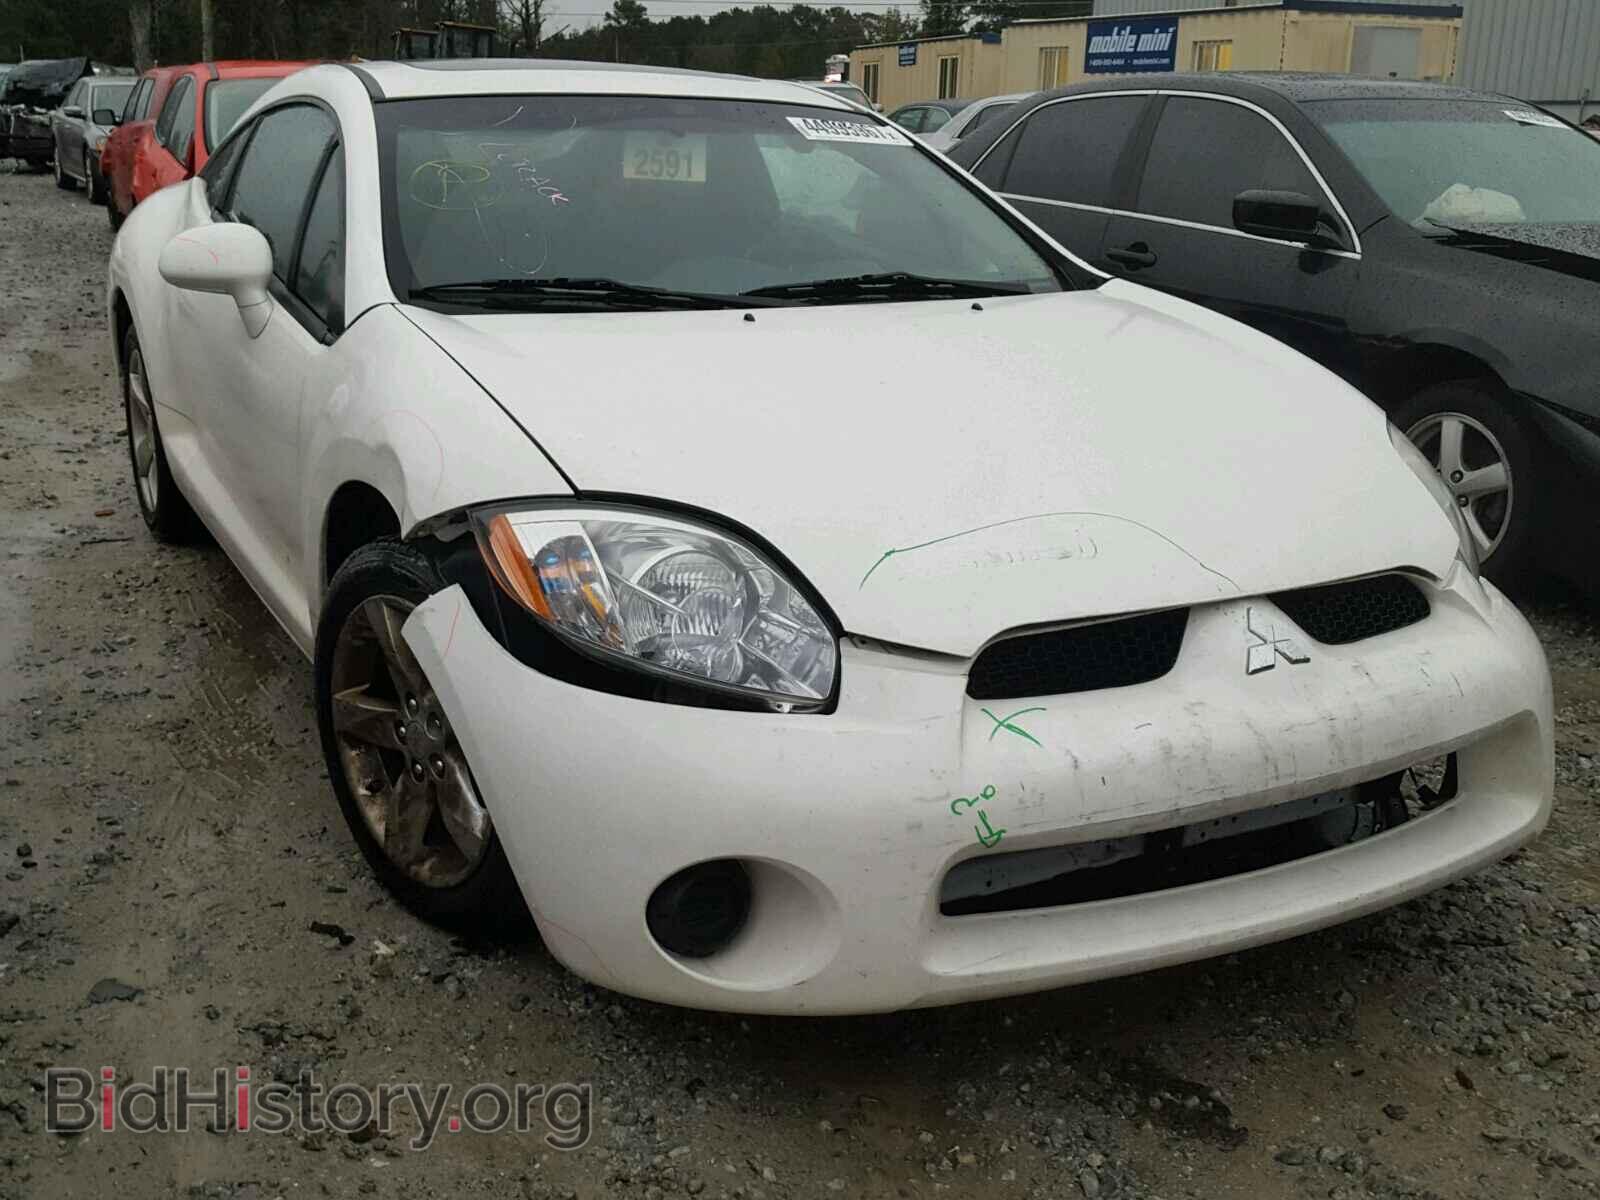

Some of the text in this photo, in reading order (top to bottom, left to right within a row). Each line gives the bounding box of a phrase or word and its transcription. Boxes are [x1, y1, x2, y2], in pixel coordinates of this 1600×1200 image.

[1088, 26, 1176, 53] mobile mini
[633, 149, 693, 178] 2591
